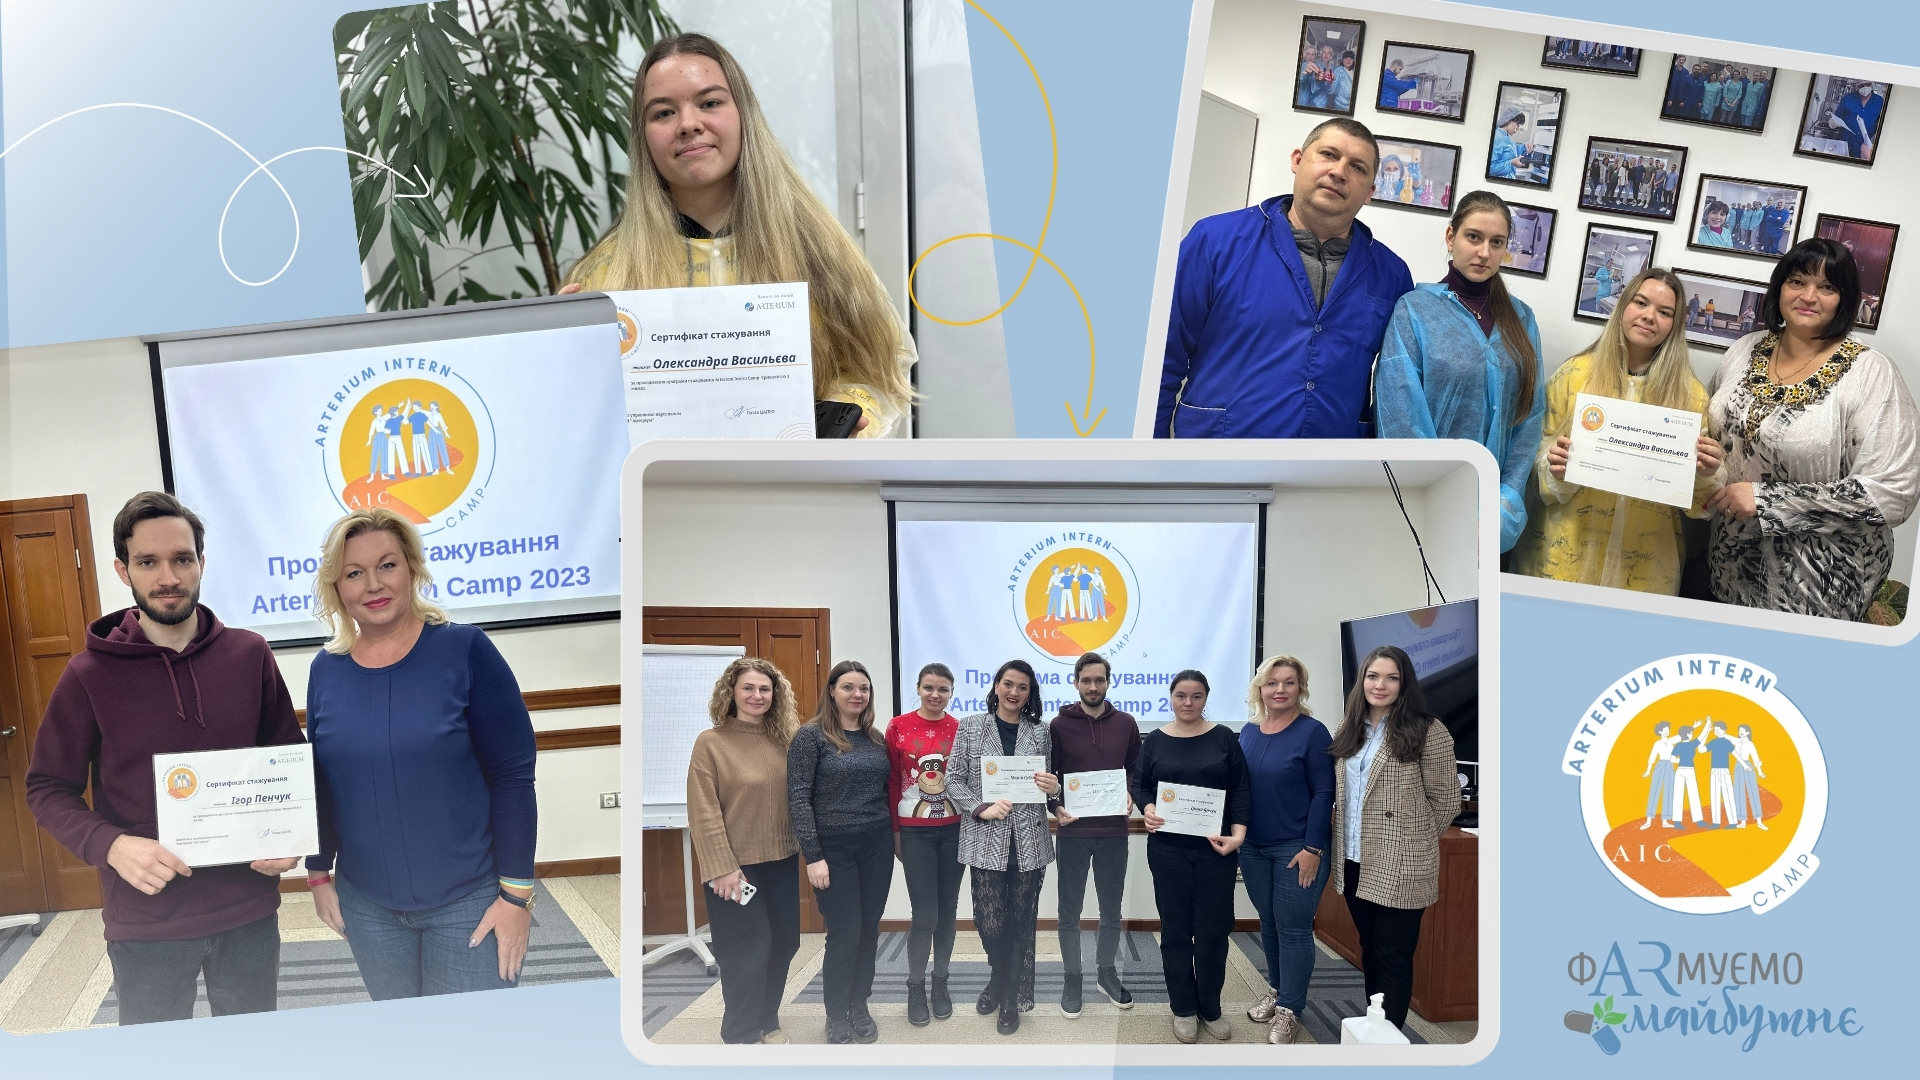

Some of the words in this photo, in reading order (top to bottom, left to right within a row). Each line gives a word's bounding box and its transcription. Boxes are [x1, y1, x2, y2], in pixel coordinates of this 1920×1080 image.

[756, 302, 795, 310] ARTERIUM
[651, 332, 708, 343] Сертифікат
[710, 329, 771, 340] стажування
[653, 356, 728, 369] Олександра
[731, 353, 796, 366] Васильєва
[314, 366, 376, 447] ARTERIUM
[384, 357, 451, 378] INTERN
[1608, 436, 1650, 450] Олександра
[1651, 445, 1689, 458] Васильєва
[349, 491, 390, 508] AIC
[445, 487, 486, 528] CAMP
[424, 534, 559, 564] ажування
[1007, 535, 1057, 592] ARTERIUM
[1063, 531, 1112, 550] INTERN
[447, 575, 521, 597] Camp
[530, 565, 591, 590] 2023
[1100, 633, 1130, 661] CAMP
[206, 779, 245, 788] Сертифікат
[247, 776, 288, 785] стажування
[231, 796, 252, 806] Ігор
[255, 793, 291, 803] Пенчук
